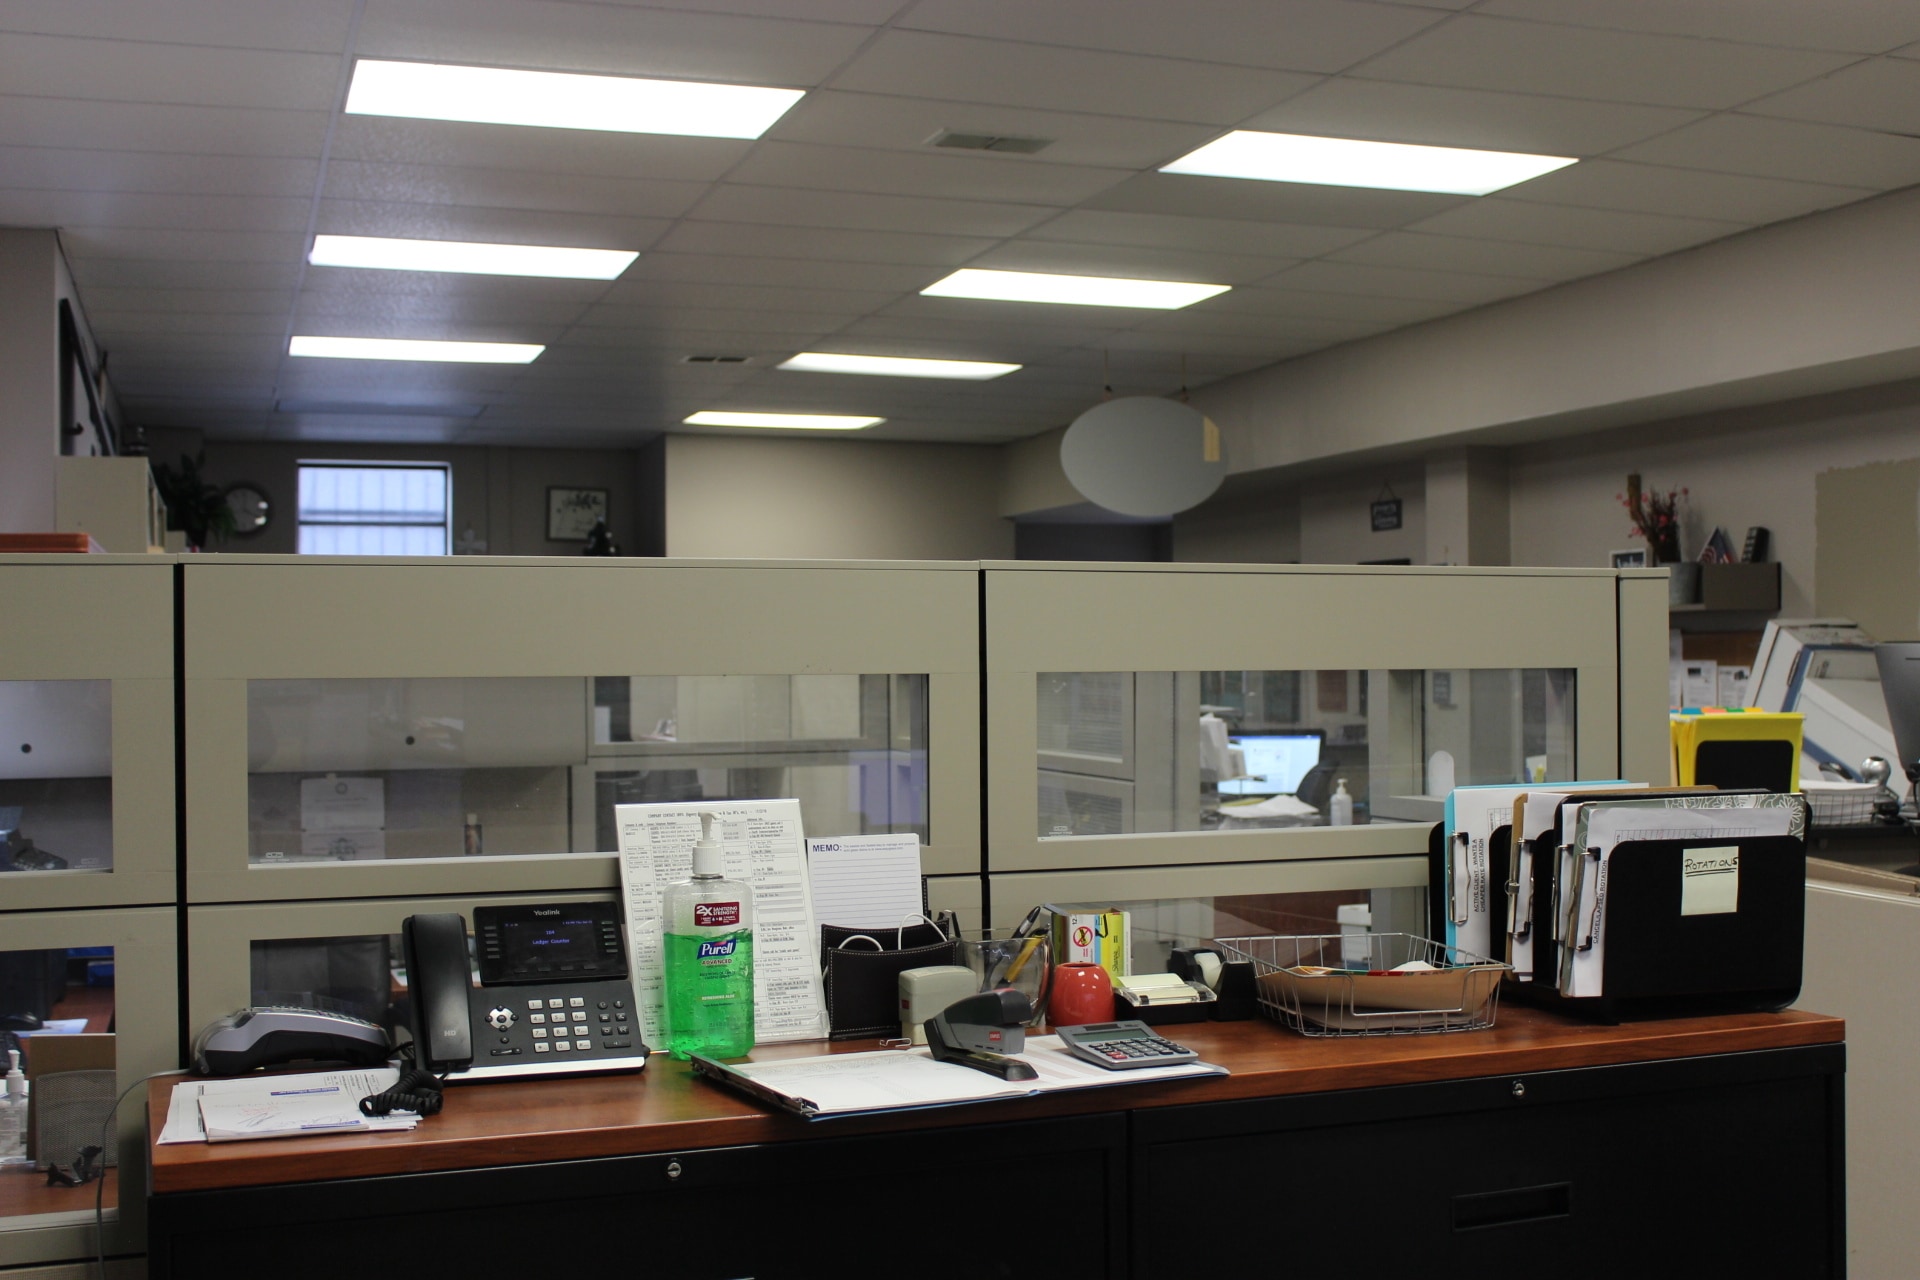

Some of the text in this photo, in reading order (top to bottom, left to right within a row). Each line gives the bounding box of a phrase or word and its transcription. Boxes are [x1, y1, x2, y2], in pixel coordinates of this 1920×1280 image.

[812, 843, 842, 853] MEMO:
[1685, 857, 1739, 871] ROTATIONS
[1599, 860, 1607, 891] ROTATION
[533, 908, 560, 916] Yealink
[696, 905, 713, 916] 2X
[701, 942, 734, 956] Purell
[443, 1029, 456, 1037] HD
